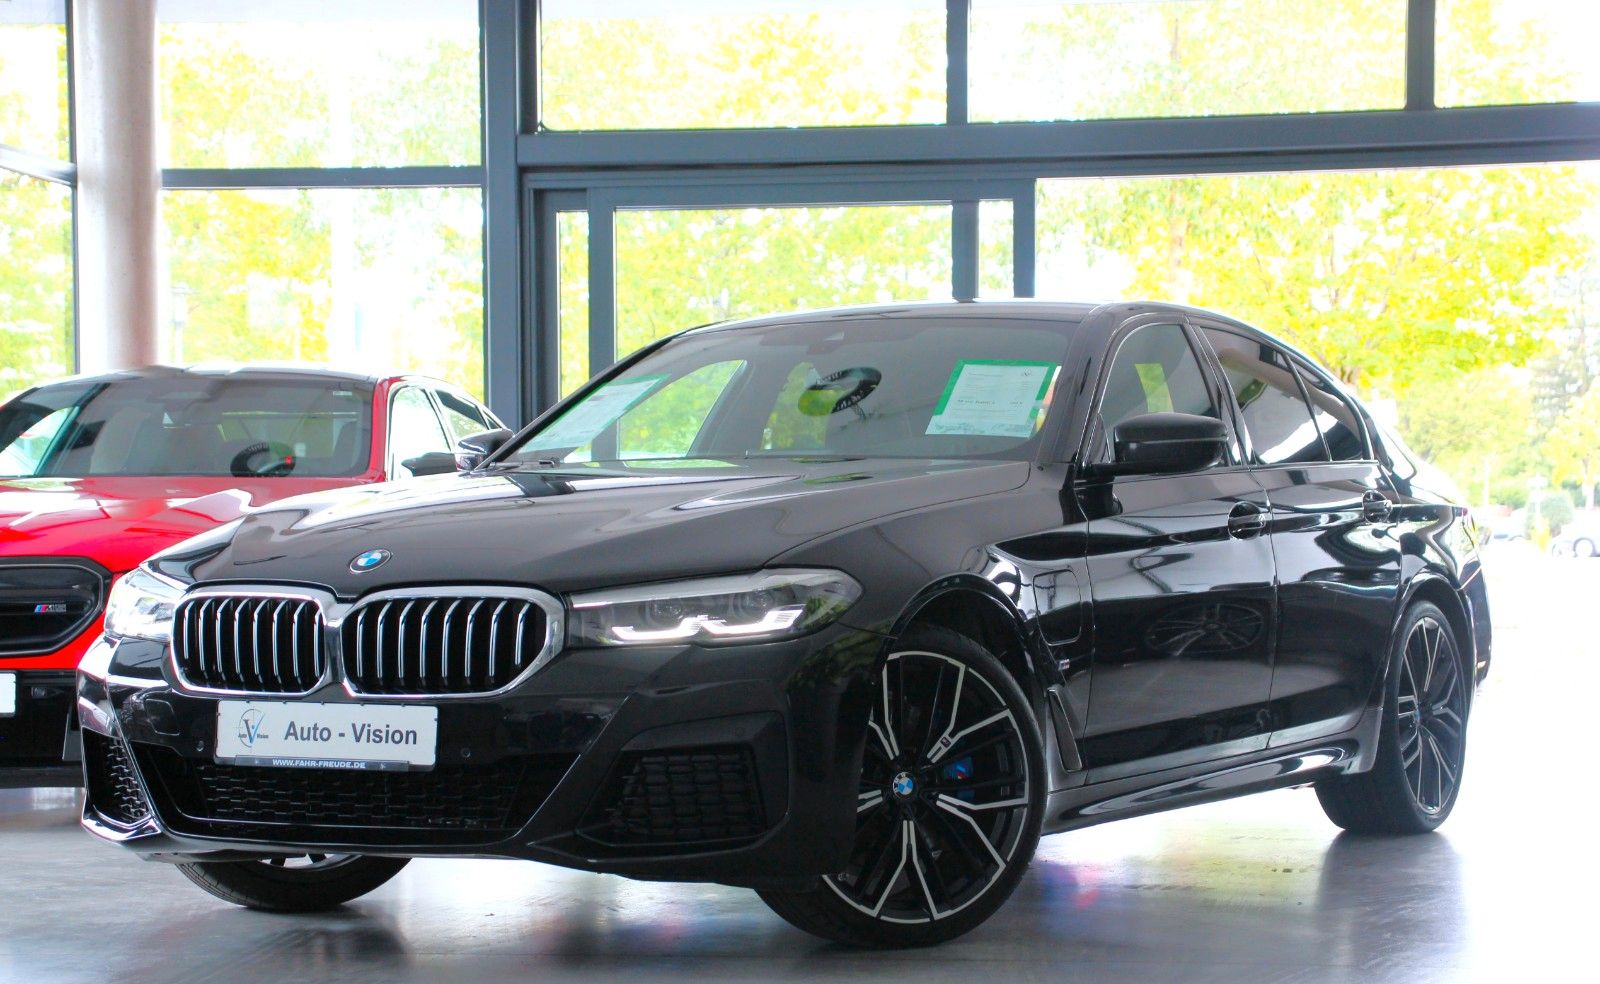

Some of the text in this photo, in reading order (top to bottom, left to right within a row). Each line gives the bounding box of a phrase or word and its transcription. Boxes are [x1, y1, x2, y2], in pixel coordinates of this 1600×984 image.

[284, 720, 332, 742] Auto
[351, 723, 417, 745] Vision
[272, 758, 366, 769] WWW.FAHR-FREUDE.DE
